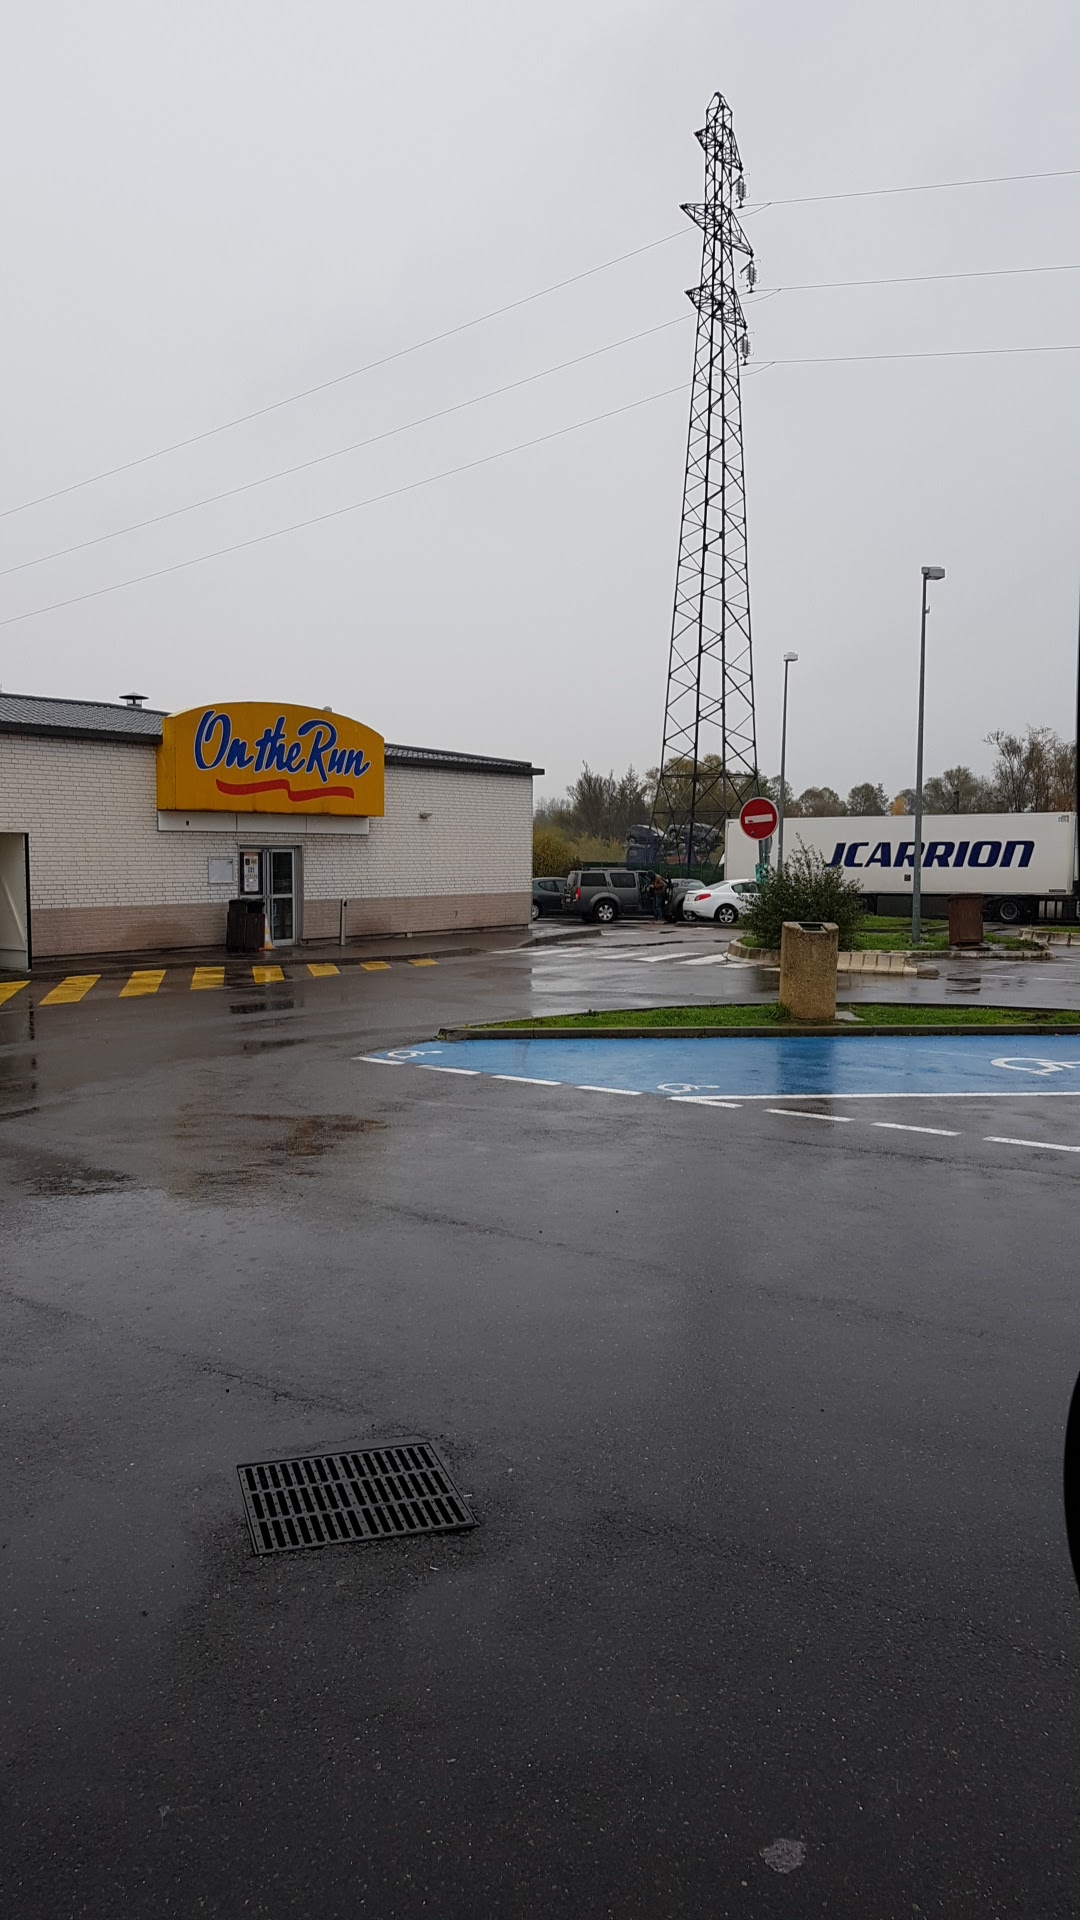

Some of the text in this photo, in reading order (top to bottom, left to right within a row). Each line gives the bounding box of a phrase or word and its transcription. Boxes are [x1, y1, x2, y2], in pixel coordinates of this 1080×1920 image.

[194, 709, 371, 783] On the Run
[824, 840, 1035, 868] JCARRION
